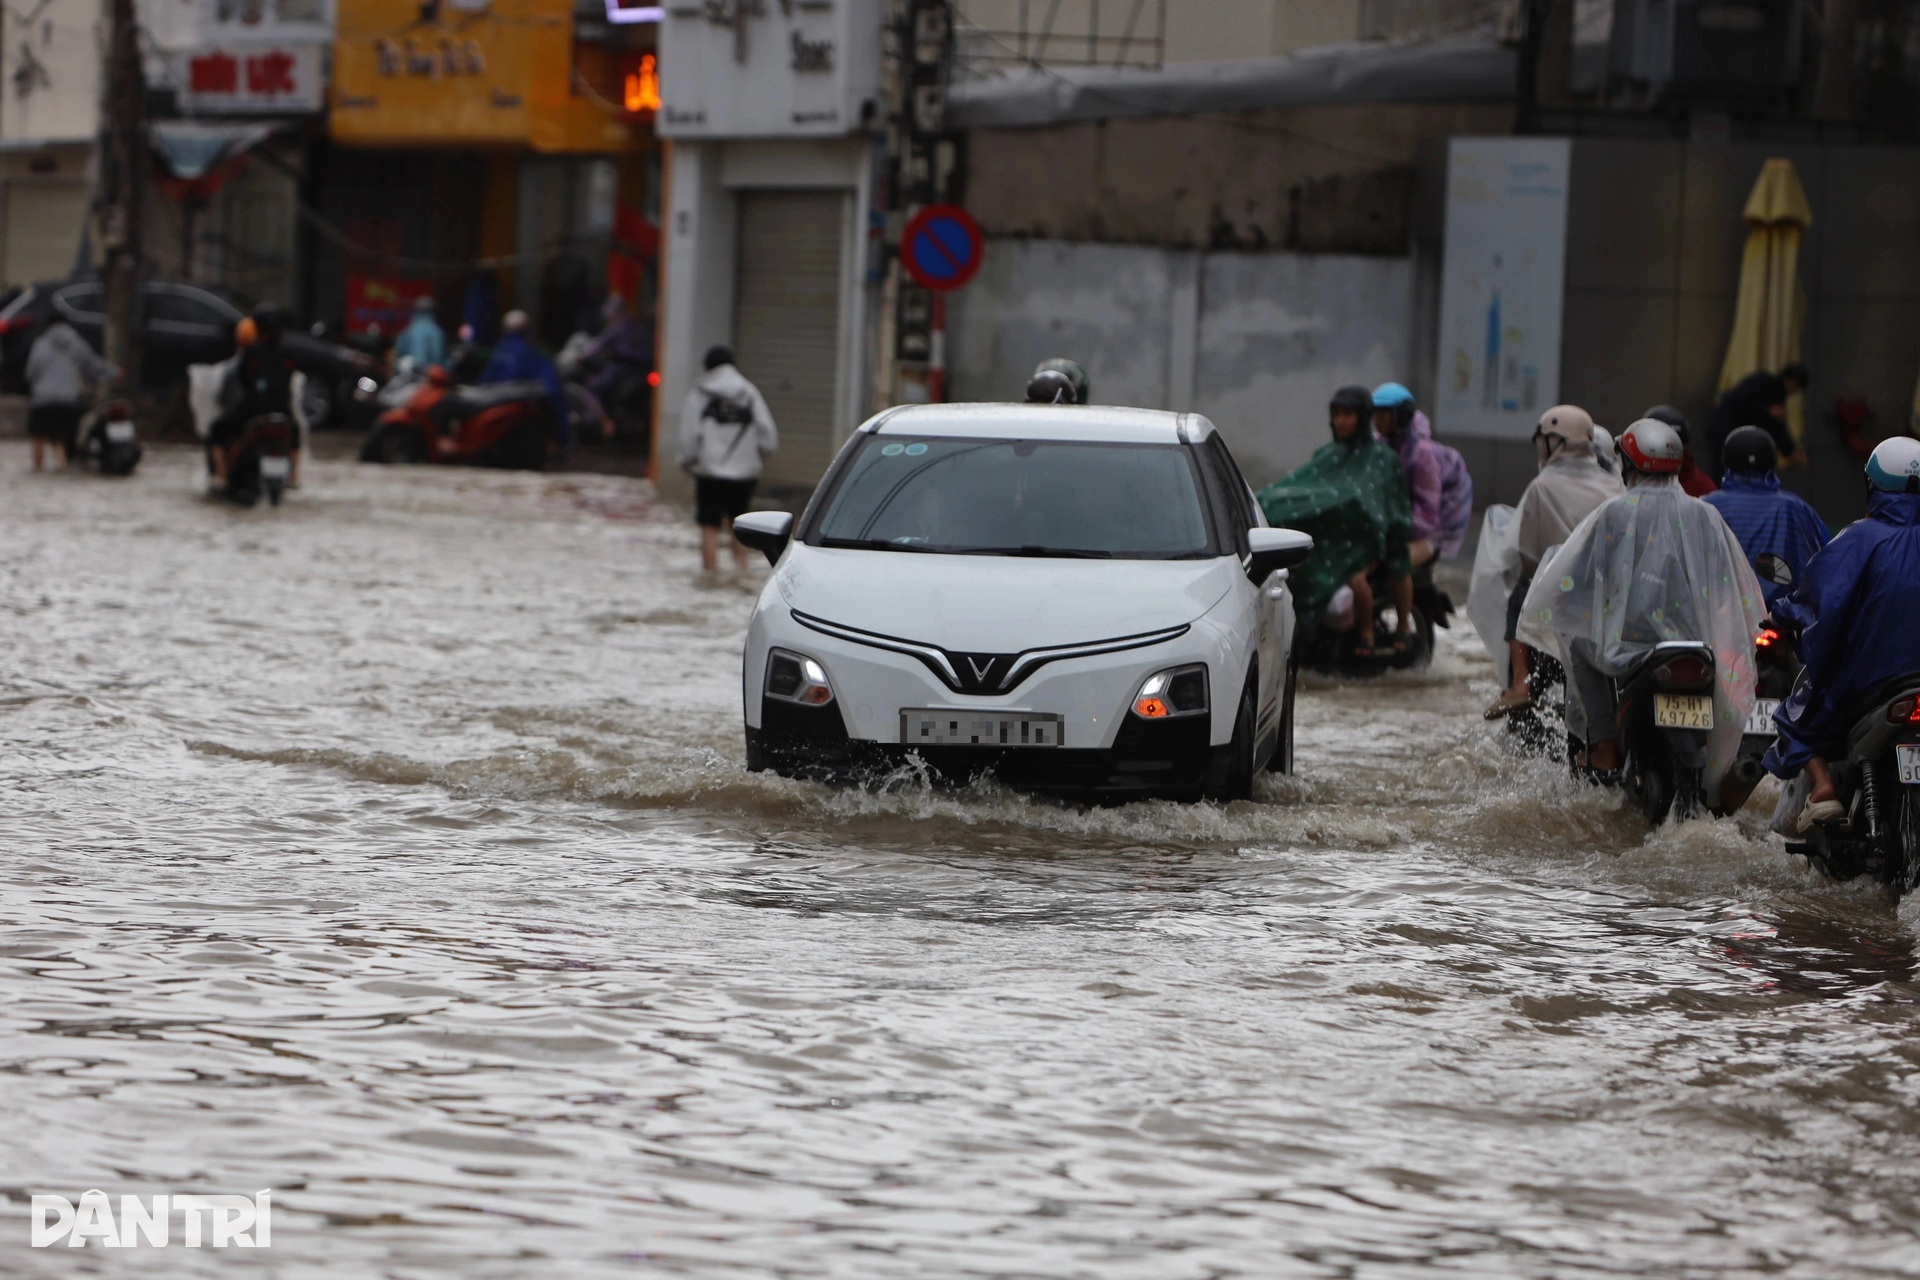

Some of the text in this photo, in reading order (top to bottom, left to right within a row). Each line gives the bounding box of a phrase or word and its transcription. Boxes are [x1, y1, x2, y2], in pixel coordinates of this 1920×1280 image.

[1757, 701, 1772, 717] AC
[1659, 711, 1710, 726] 497.26
[1749, 717, 1777, 731] 1.93
